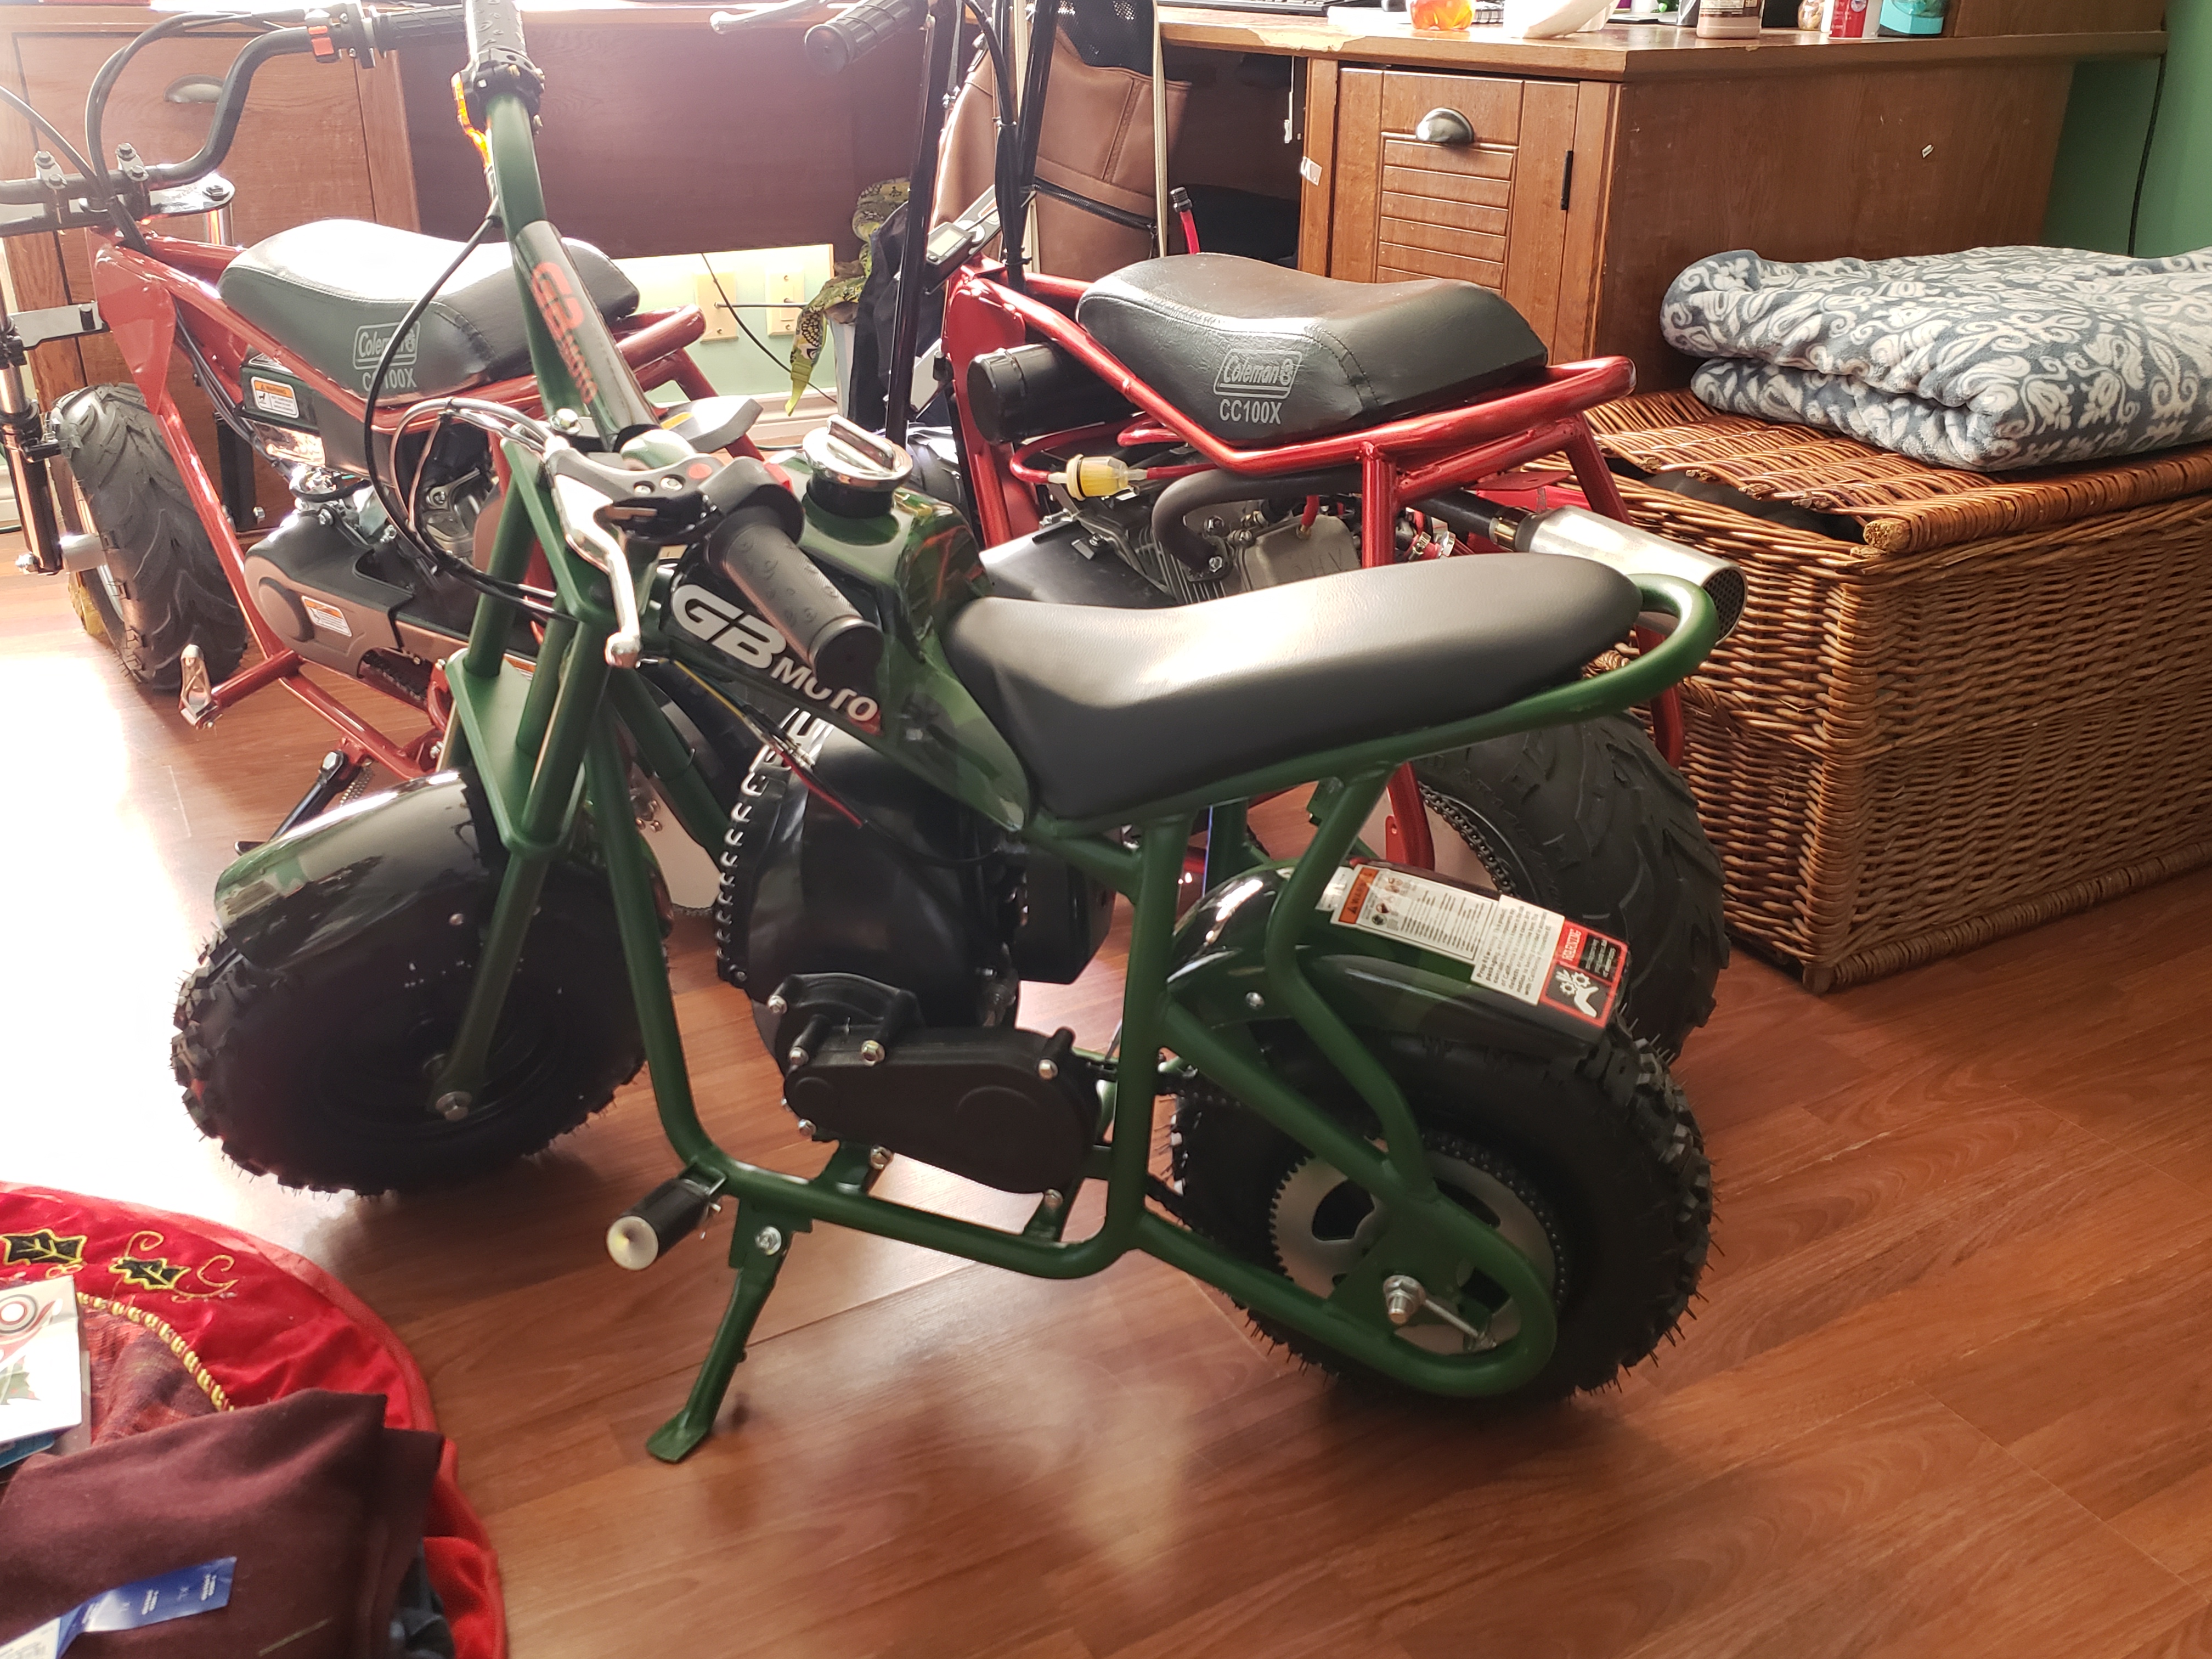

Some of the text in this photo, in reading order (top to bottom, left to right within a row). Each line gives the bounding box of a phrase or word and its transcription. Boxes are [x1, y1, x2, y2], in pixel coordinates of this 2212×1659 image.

[358, 331, 405, 358] Colemn
[363, 368, 417, 392] C100X
[1223, 357, 1282, 383] Coleman
[1219, 399, 1283, 425] CC100X
[673, 584, 787, 669] GB
